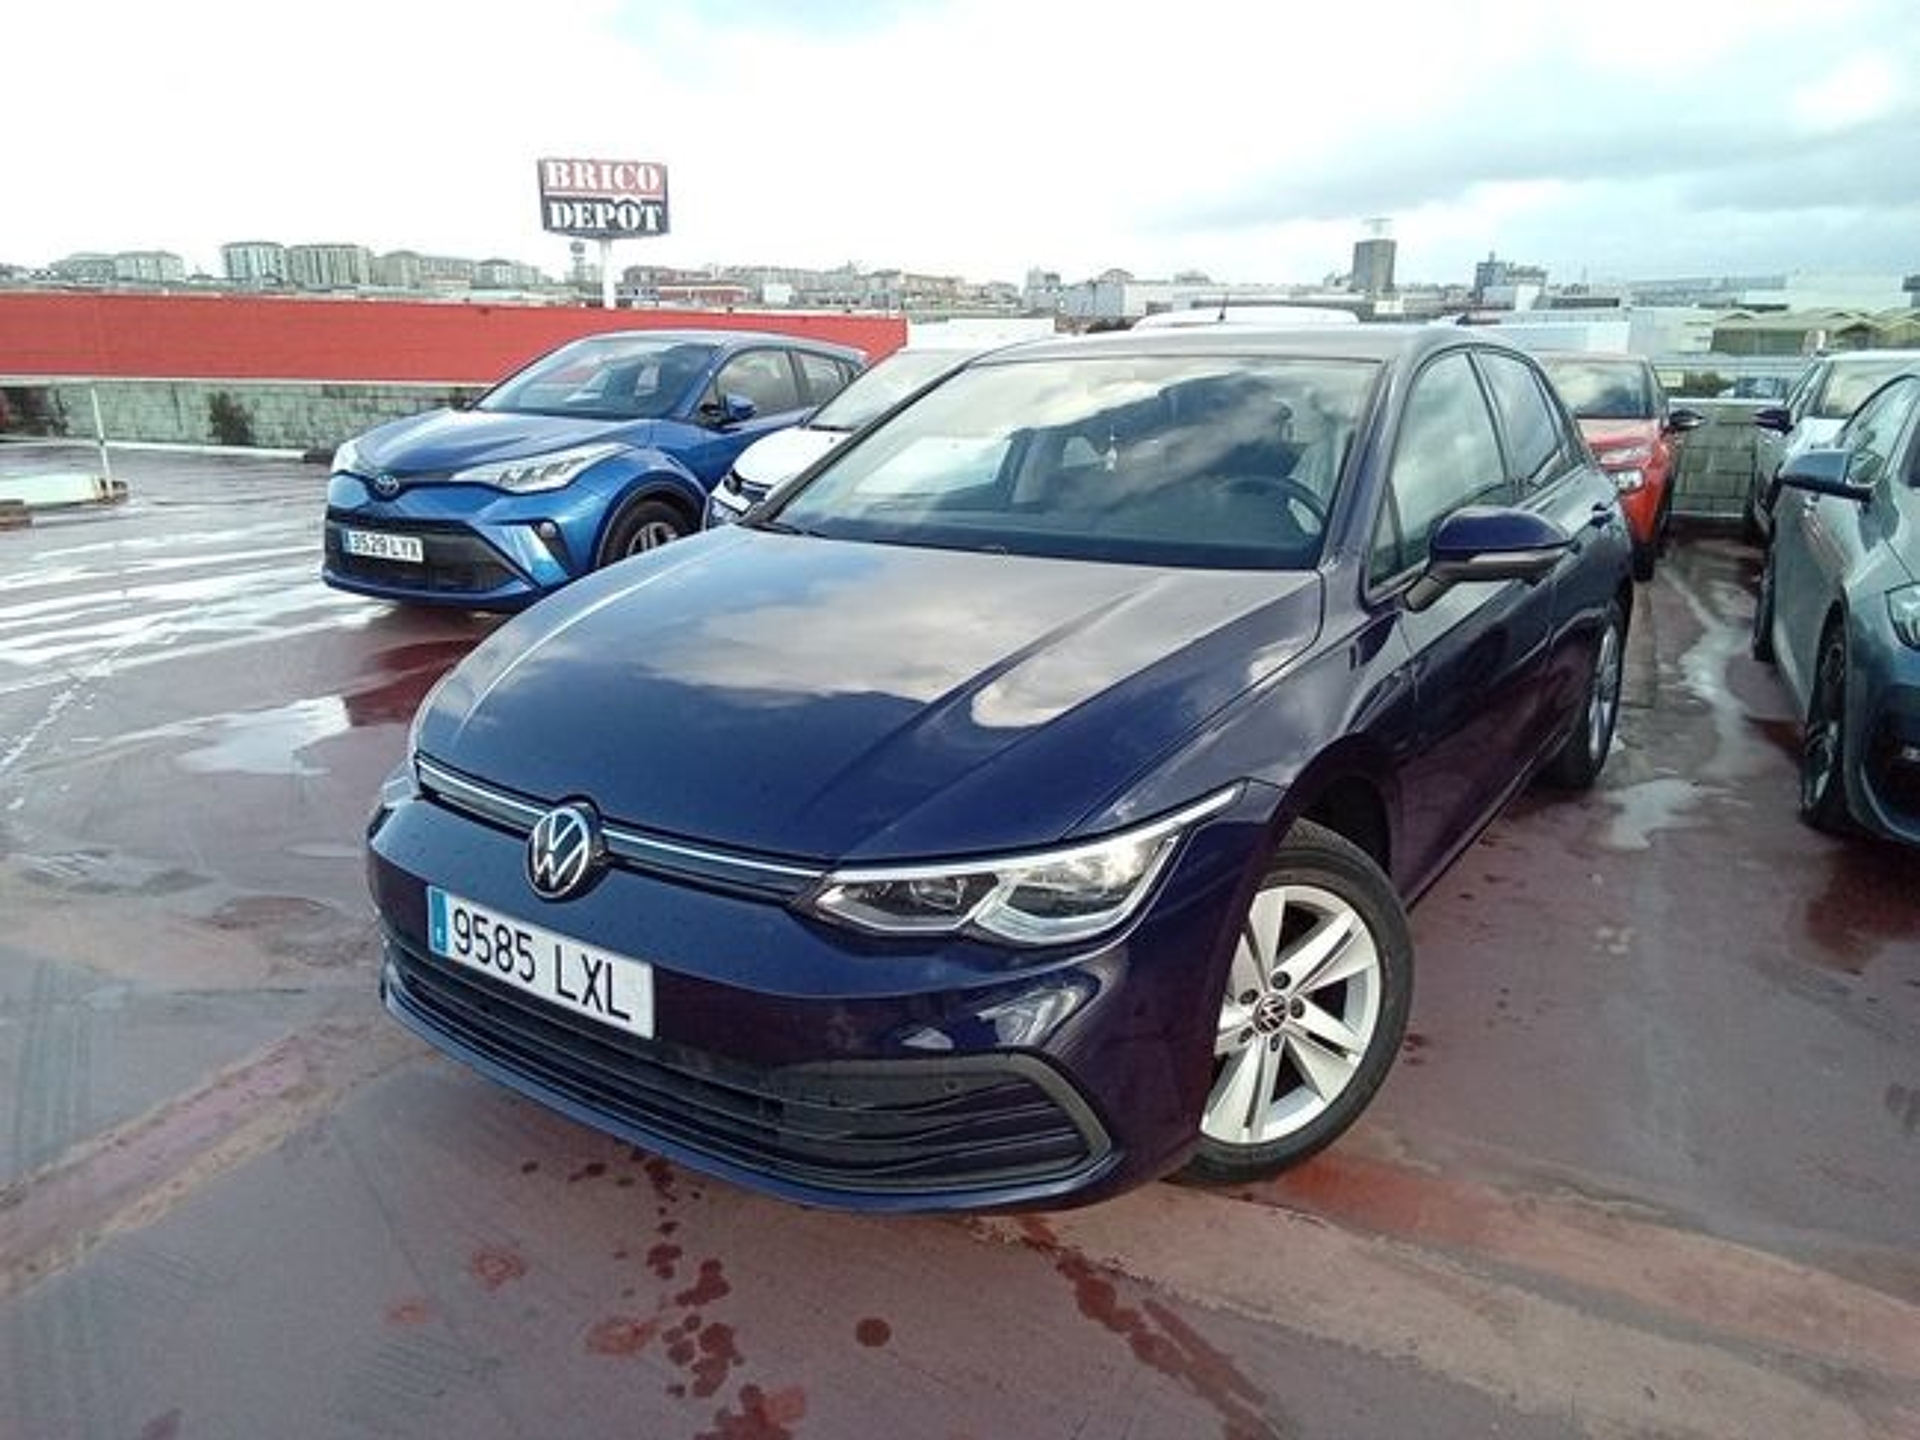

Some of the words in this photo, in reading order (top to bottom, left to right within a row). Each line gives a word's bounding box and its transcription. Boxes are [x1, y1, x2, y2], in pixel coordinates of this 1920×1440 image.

[545, 161, 660, 190] BRICO
[453, 907, 536, 983] 9585
[555, 944, 631, 1022] LXL
